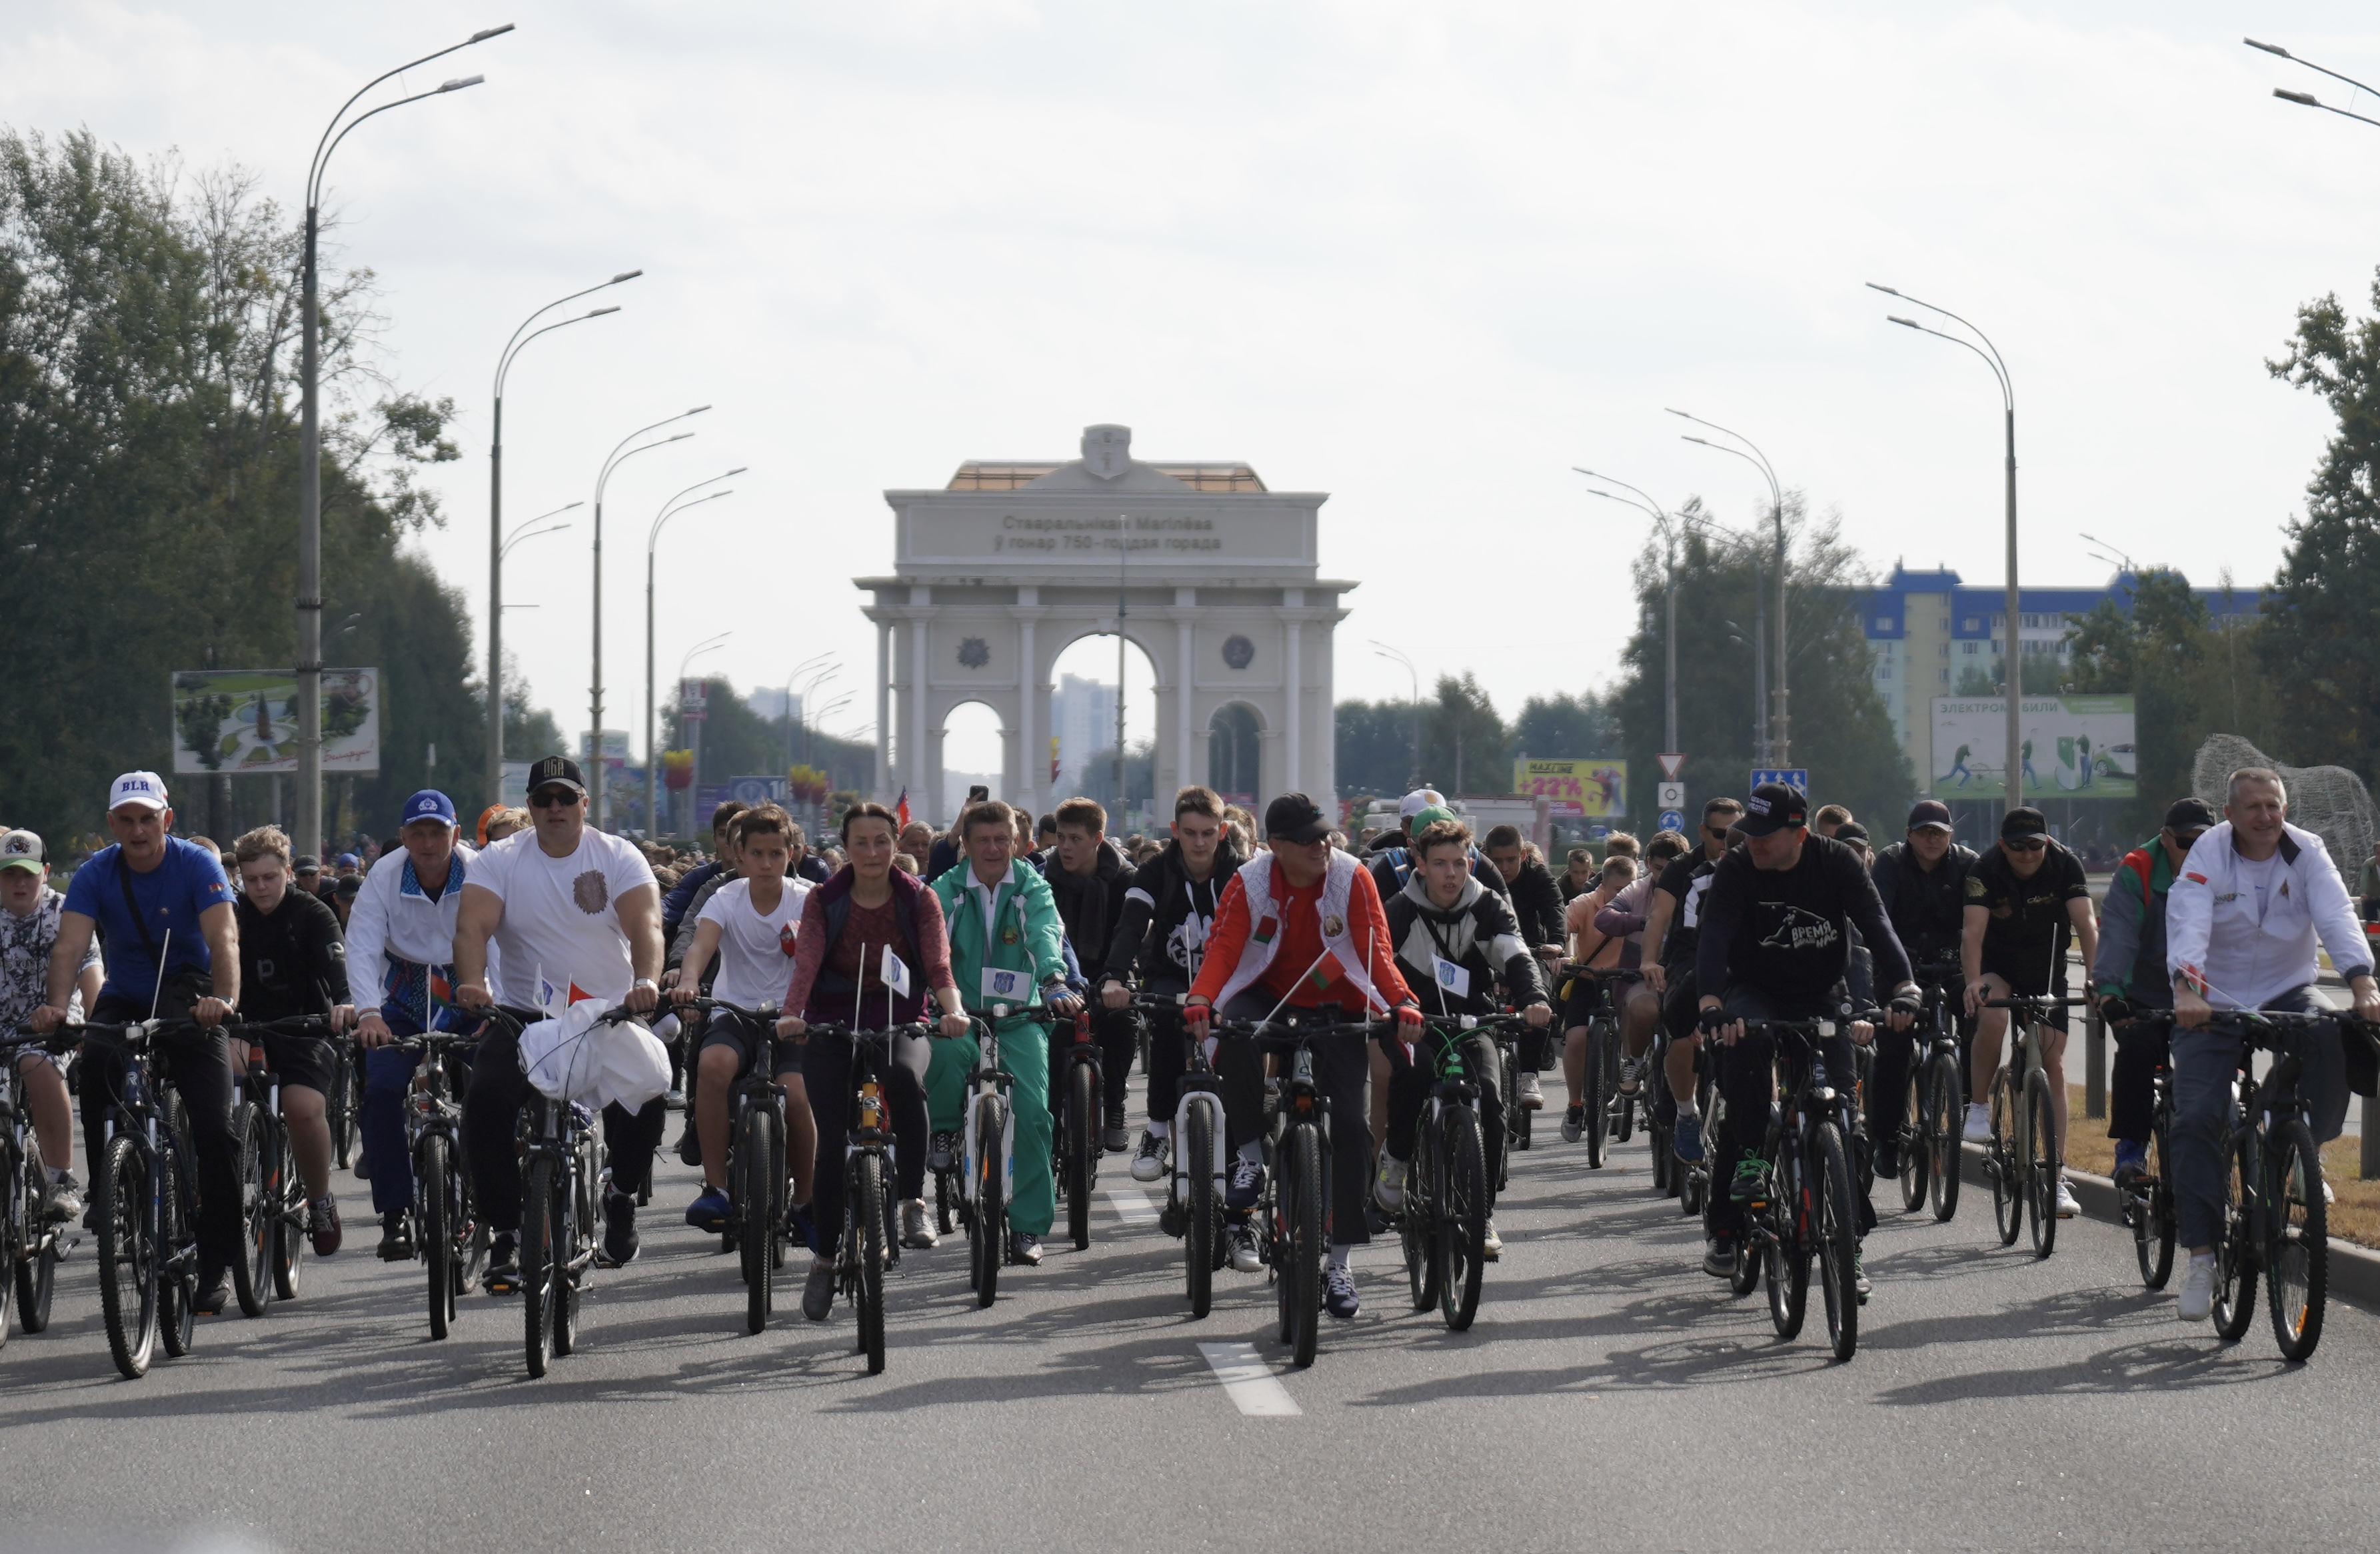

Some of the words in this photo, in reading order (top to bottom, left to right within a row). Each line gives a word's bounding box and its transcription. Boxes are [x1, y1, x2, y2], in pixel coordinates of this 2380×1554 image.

[1136, 516, 1213, 531] Магілёва
[1009, 537, 1056, 551] гонар
[1164, 537, 1222, 551] горада
[1940, 702, 2058, 713] ЭЛЕКТРОМБИЛИ
[121, 780, 150, 792] BLR
[1519, 775, 1582, 796] +22%
[1791, 920, 1831, 941] ВРЕМЯ
[1815, 929, 1837, 947] НАС
